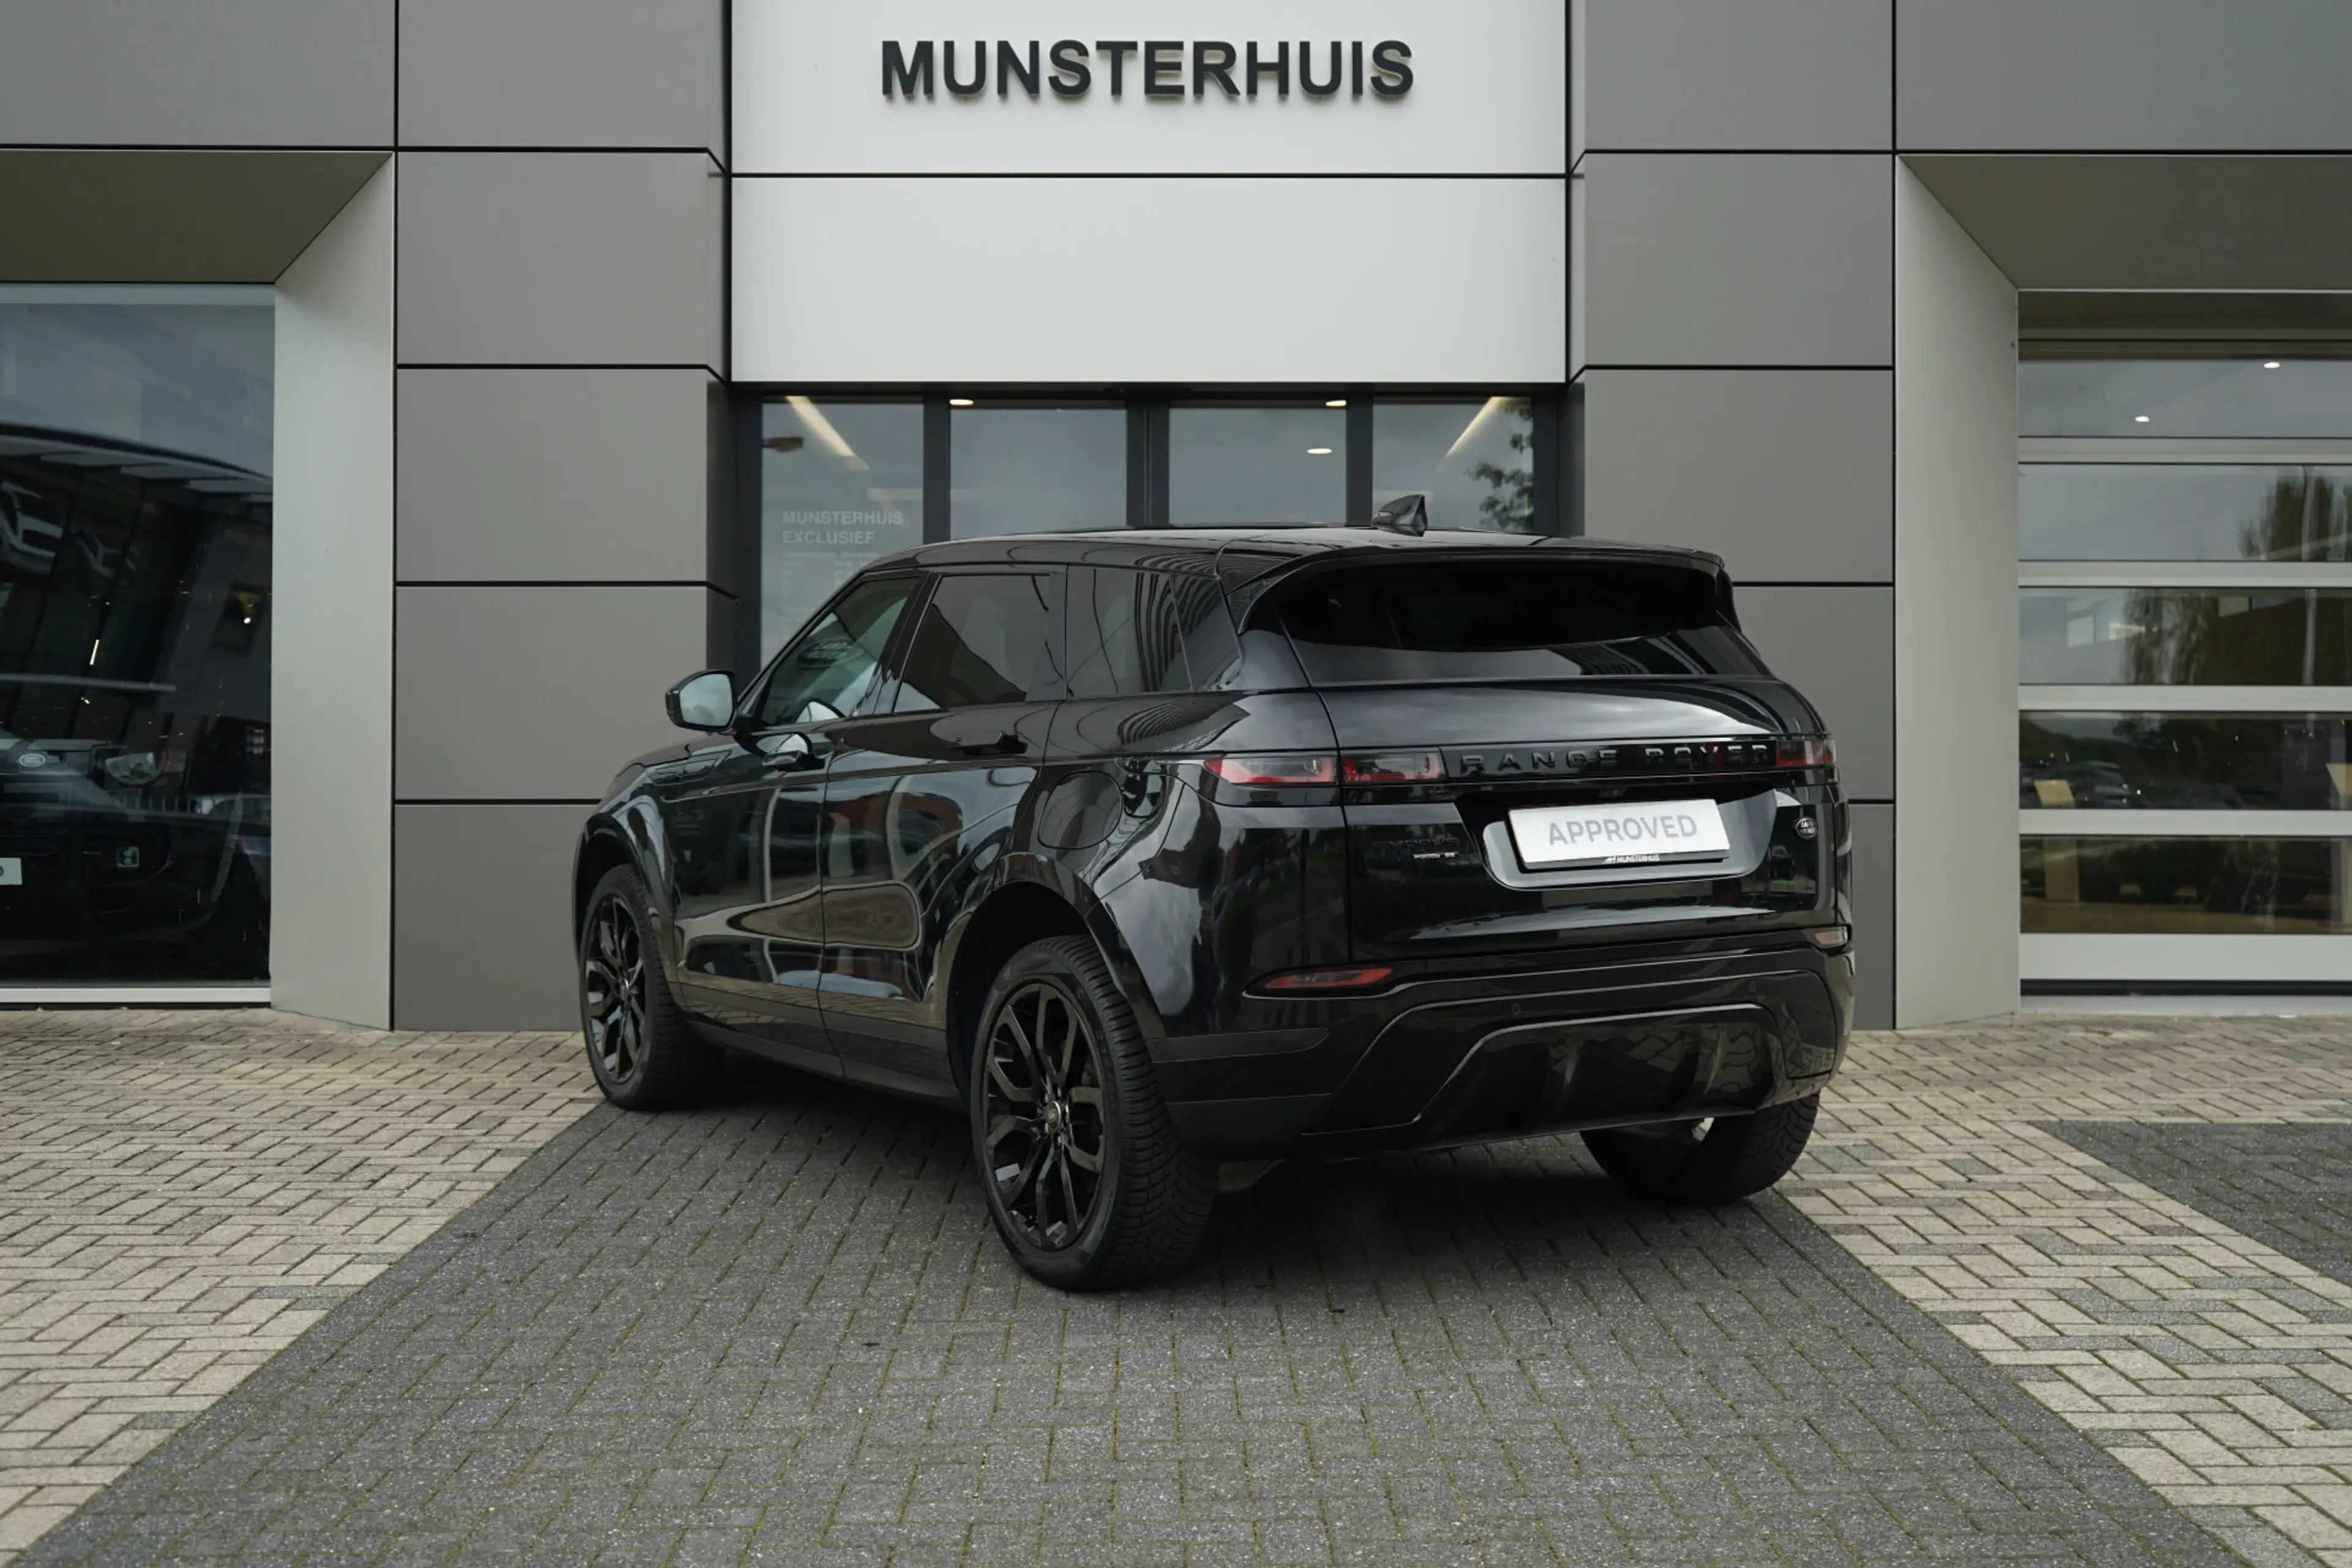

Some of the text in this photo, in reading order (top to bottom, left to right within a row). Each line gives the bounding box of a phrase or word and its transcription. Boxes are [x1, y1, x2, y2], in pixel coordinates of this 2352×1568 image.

[882, 40, 1414, 97] MUNSTERHUIS
[782, 510, 904, 525] MUNSTERHUIS
[782, 530, 875, 545] EXCLUSIEF
[1460, 744, 1768, 775] RANGE ROVER
[1549, 815, 1697, 846] APPROVED
